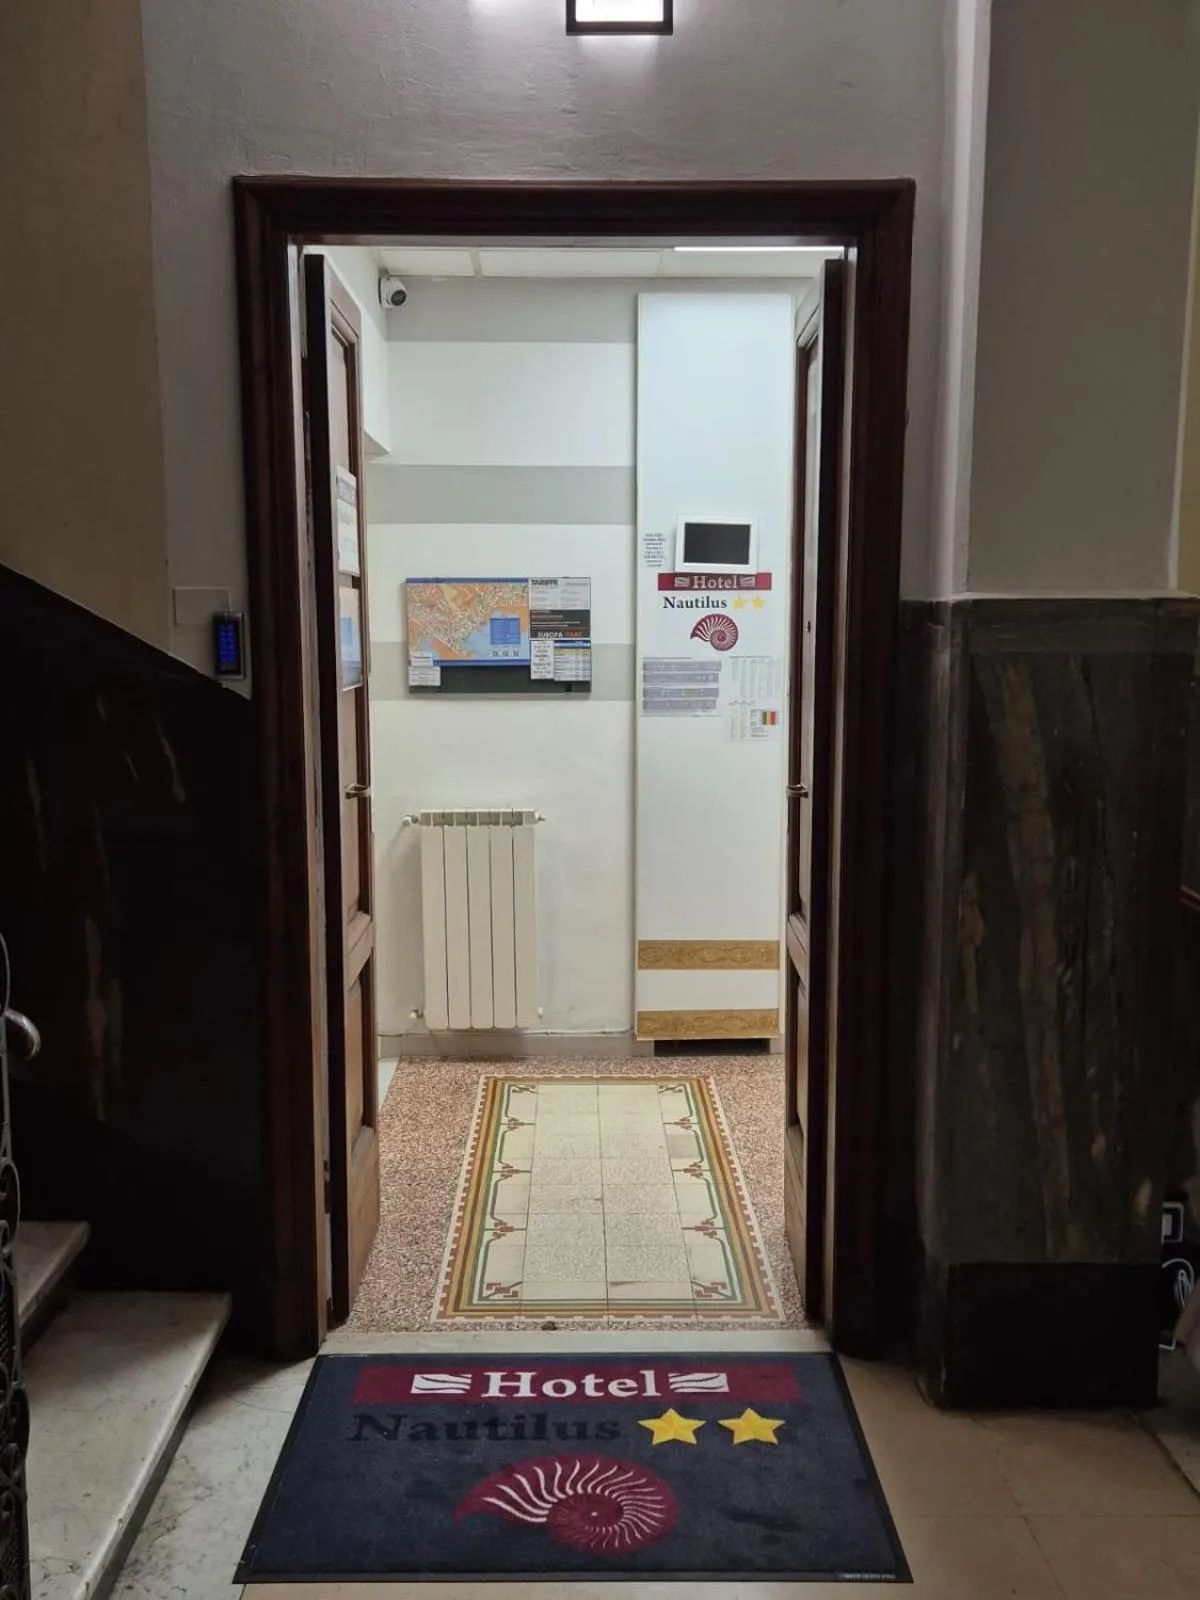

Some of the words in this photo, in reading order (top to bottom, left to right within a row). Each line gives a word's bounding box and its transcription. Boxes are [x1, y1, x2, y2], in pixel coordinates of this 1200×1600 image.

[692, 575, 738, 588] Hotel
[663, 596, 727, 609] Nautilus
[480, 1370, 661, 1397] Hotel
[345, 1413, 621, 1442] Nautilus
